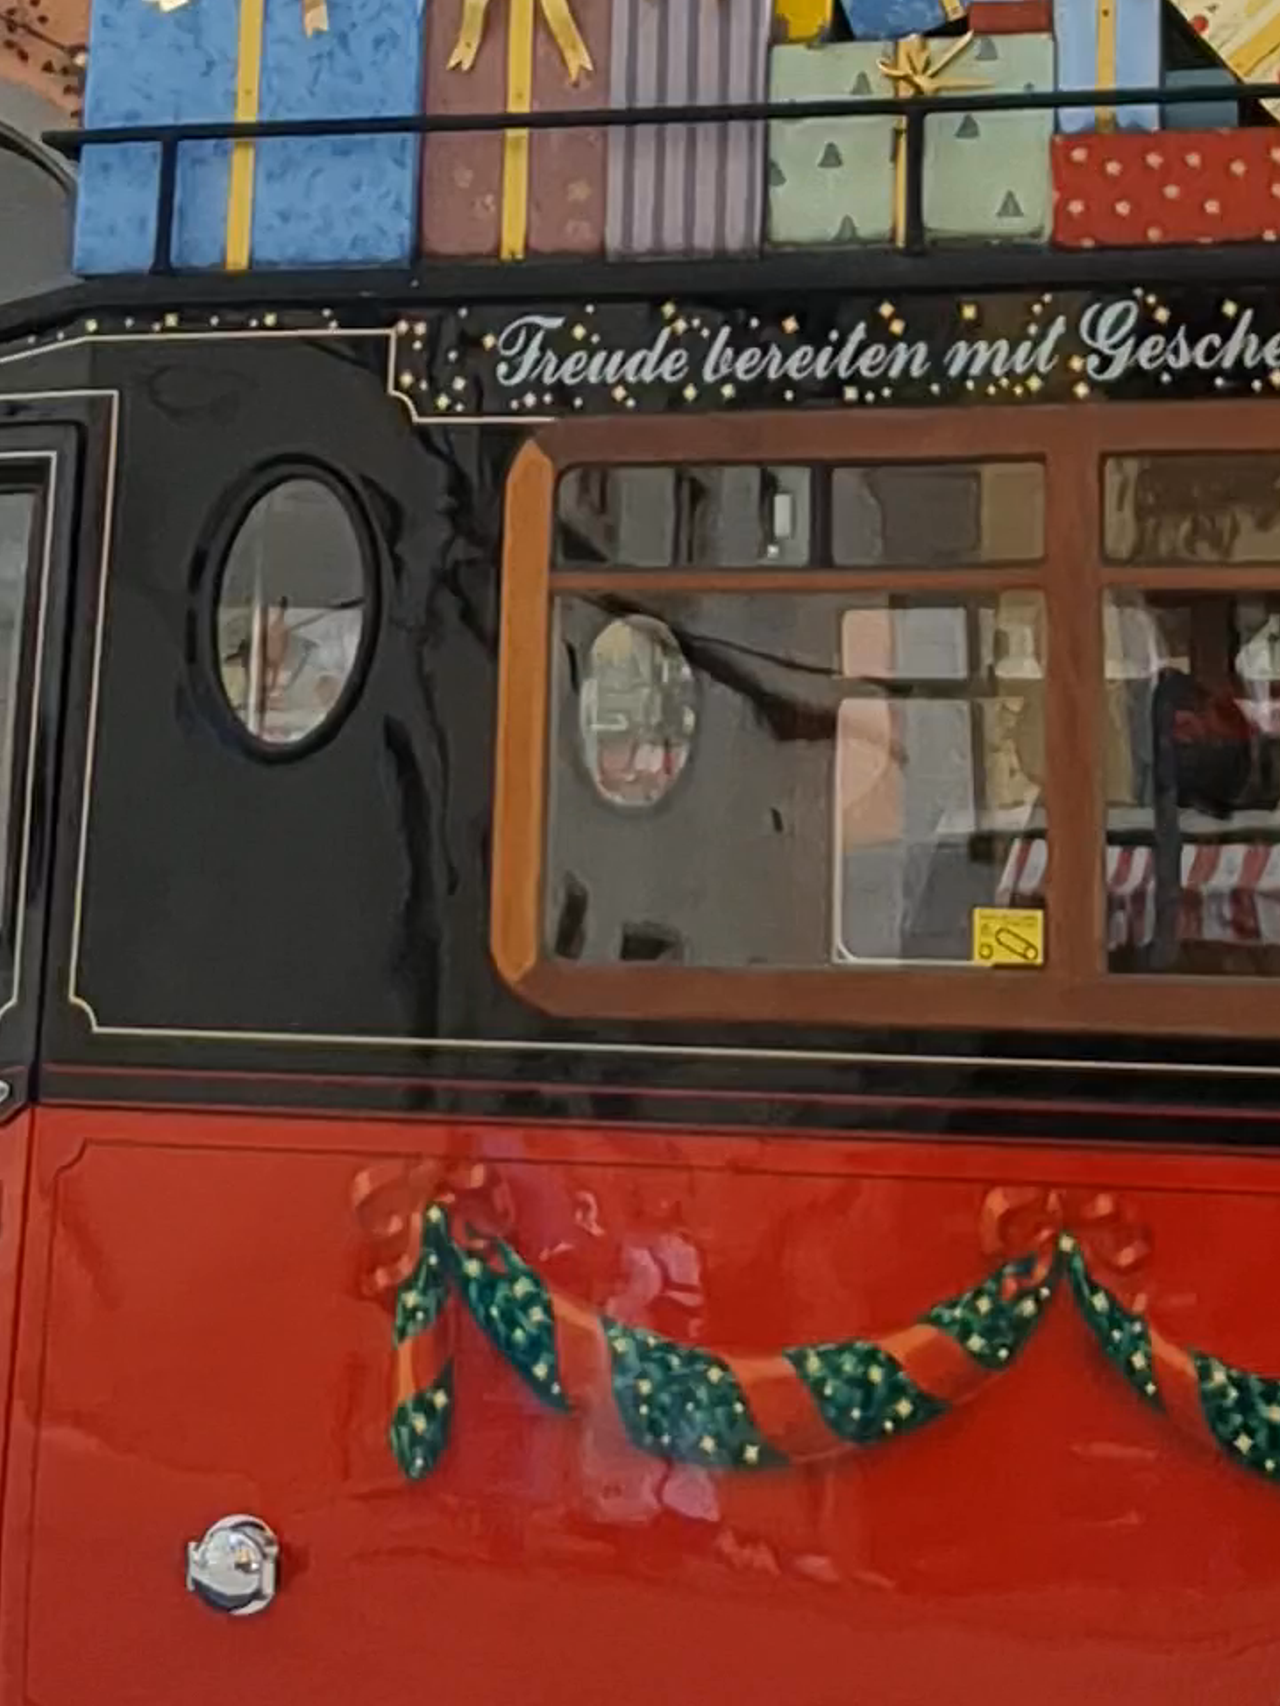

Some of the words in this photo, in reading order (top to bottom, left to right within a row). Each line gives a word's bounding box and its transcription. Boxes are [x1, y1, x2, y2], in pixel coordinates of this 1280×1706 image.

[496, 315, 690, 386] Freude
[703, 321, 928, 383] bereiten
[942, 315, 1067, 377] mit
